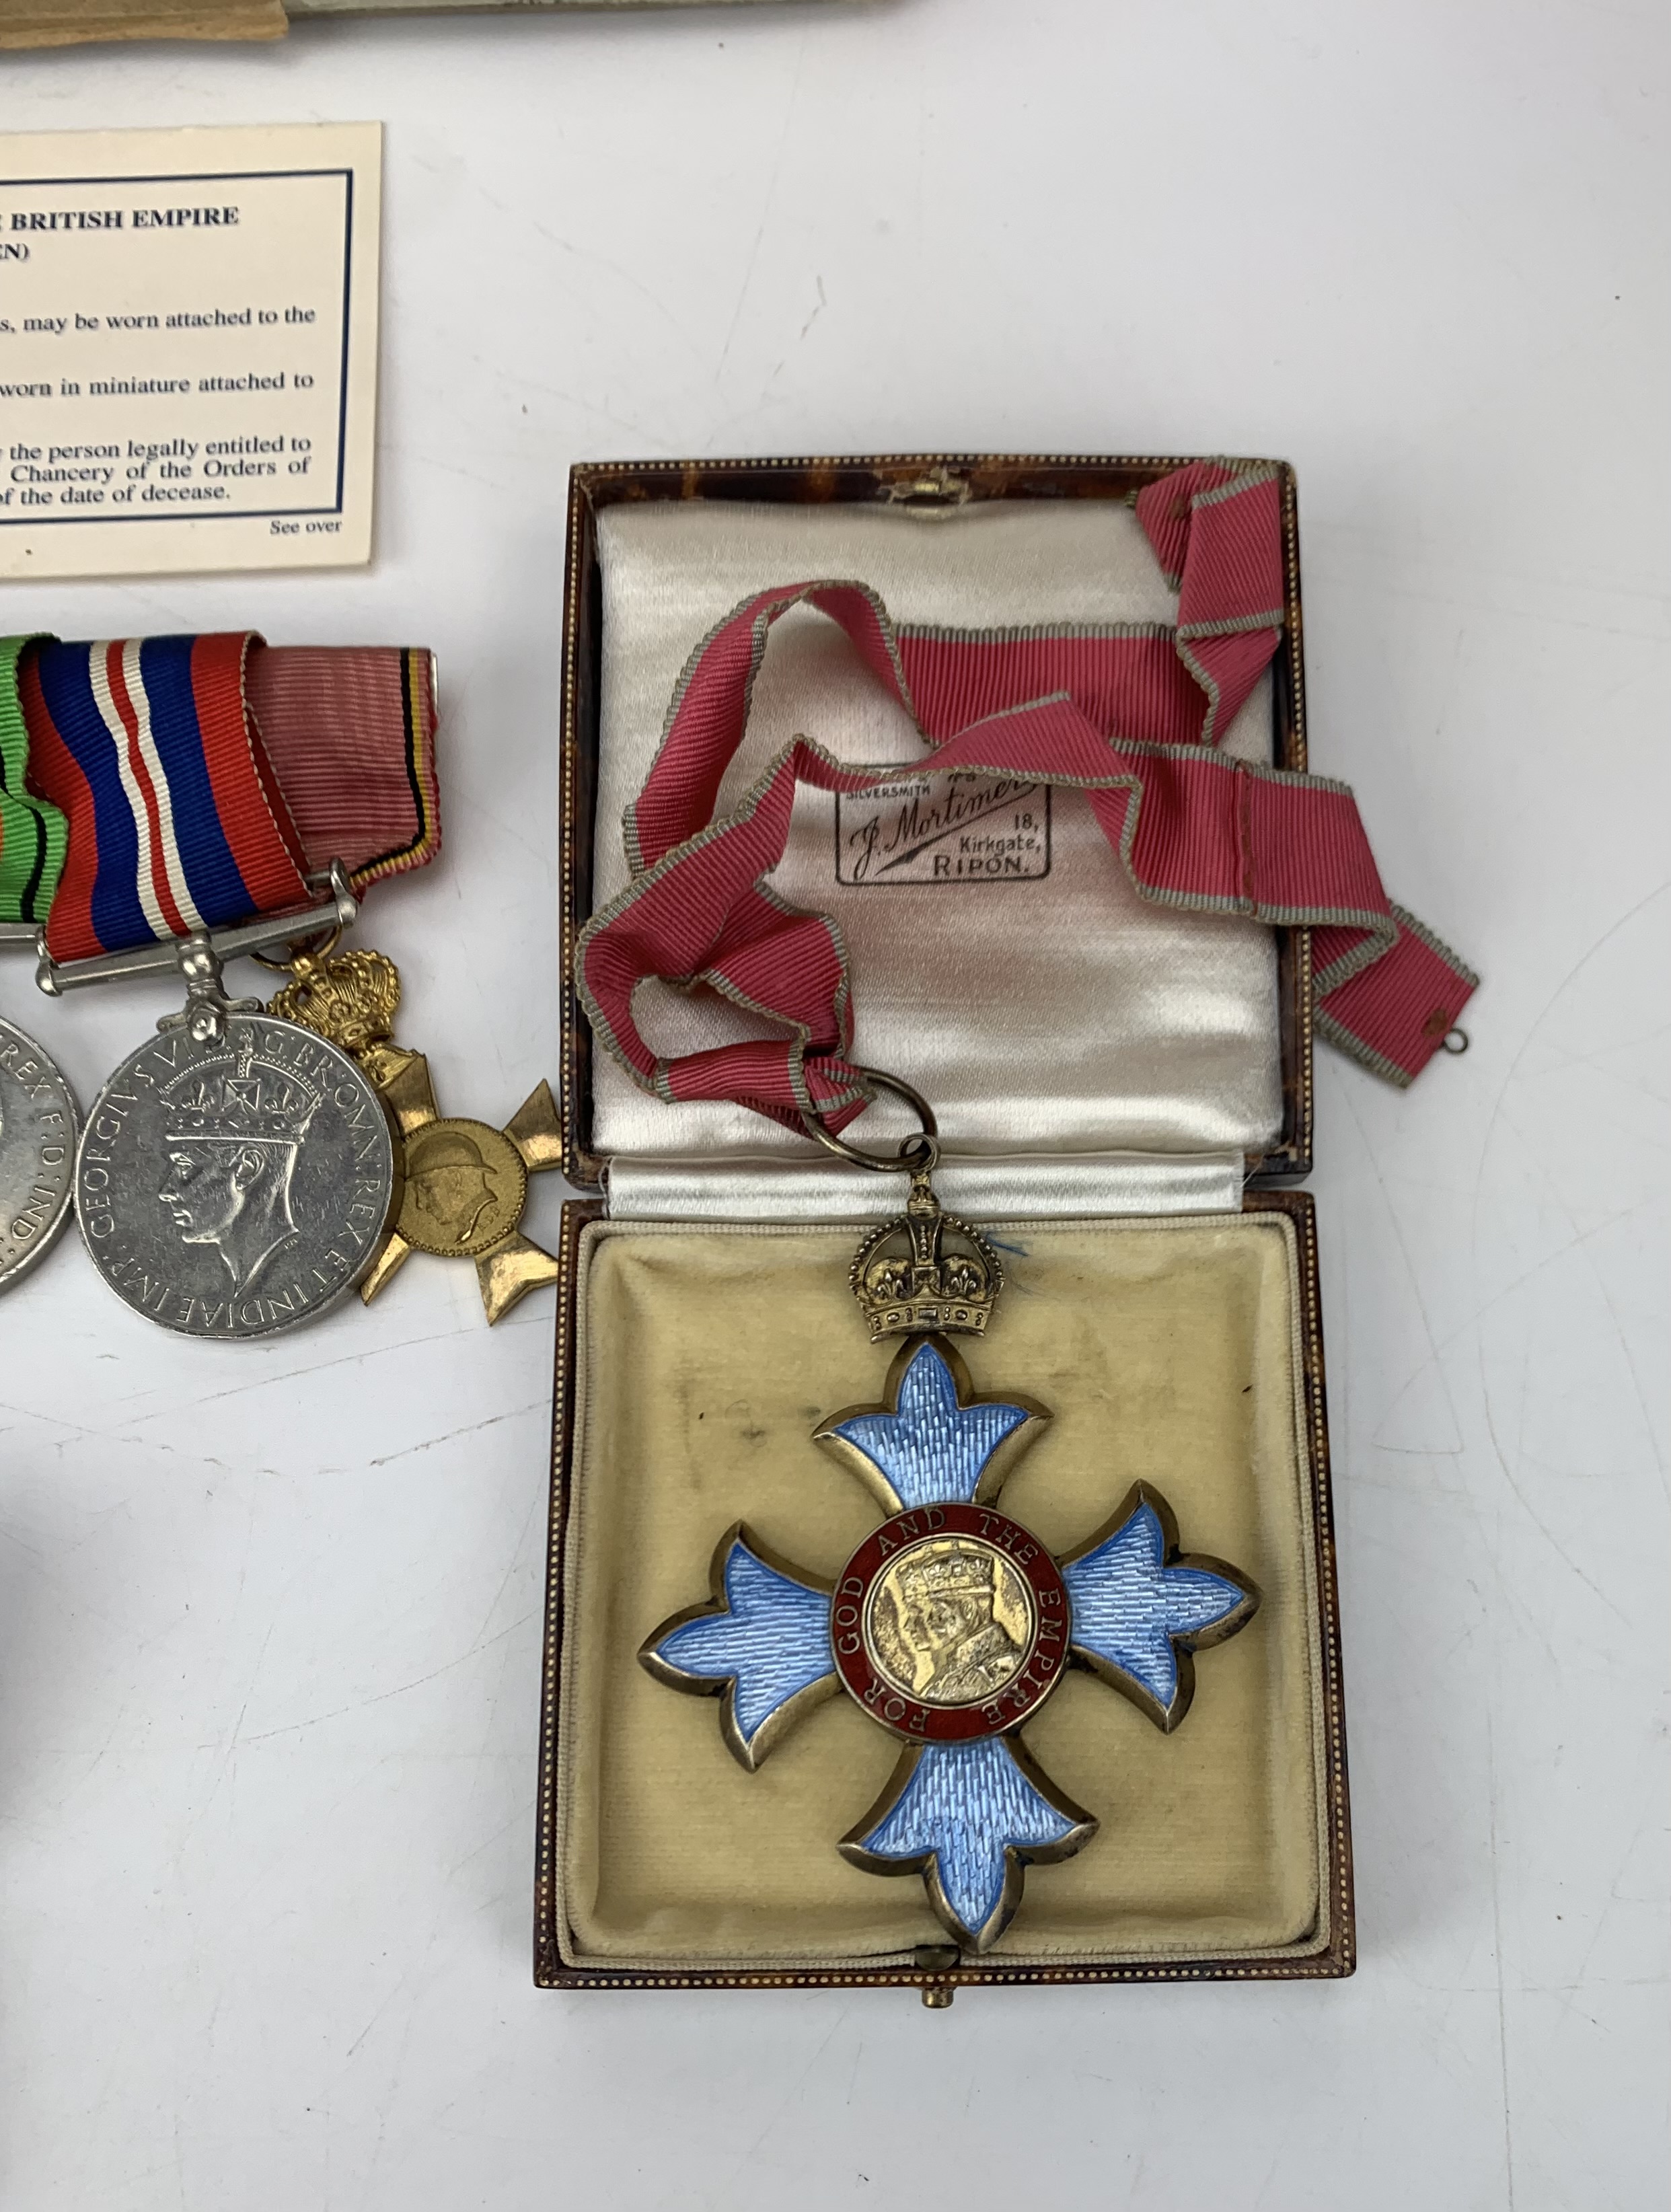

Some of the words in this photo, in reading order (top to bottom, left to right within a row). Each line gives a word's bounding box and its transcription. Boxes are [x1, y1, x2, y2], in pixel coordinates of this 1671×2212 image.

[10, 210, 123, 231] BRITISH
[133, 205, 239, 228] EMPIRE
[24, 317, 67, 335] may
[75, 312, 99, 329] be
[106, 315, 159, 329] worn
[165, 307, 251, 328] attached
[258, 309, 278, 324] to
[285, 305, 315, 324] the
[0, 383, 52, 397] worn
[61, 377, 80, 395] in
[89, 375, 190, 395] miniature
[198, 371, 285, 392] attached
[294, 373, 313, 389] to
[10, 443, 42, 460] the
[48, 445, 120, 464] person
[127, 439, 198, 460] legally
[205, 435, 285, 455] entitled
[291, 437, 311, 451] to
[10, 464, 114, 484] Chancery
[126, 460, 151, 479] of
[160, 461, 192, 478] the
[203, 459, 276, 478] Orders
[288, 456, 311, 474] of
[20, 488, 52, 505] the
[60, 486, 104, 503] date
[112, 484, 137, 503] of
[141, 483, 231, 503] decease.
[270, 519, 300, 534] See
[305, 519, 342, 533] over
[1014, 813, 1039, 833] 18,
[960, 835, 1041, 856] Kirkgate,
[934, 854, 1029, 876] RIPON.
[83, 1063, 155, 1239] GEORGIVS
[311, 1247, 350, 1293] ET
[176, 1282, 309, 1329] INDIAE
[877, 1508, 946, 1557] AND
[979, 1512, 1039, 1565] THE
[836, 1576, 864, 1655] GOD
[980, 1588, 1064, 1726] EMPIRE
[863, 1680, 931, 1733] FOR
